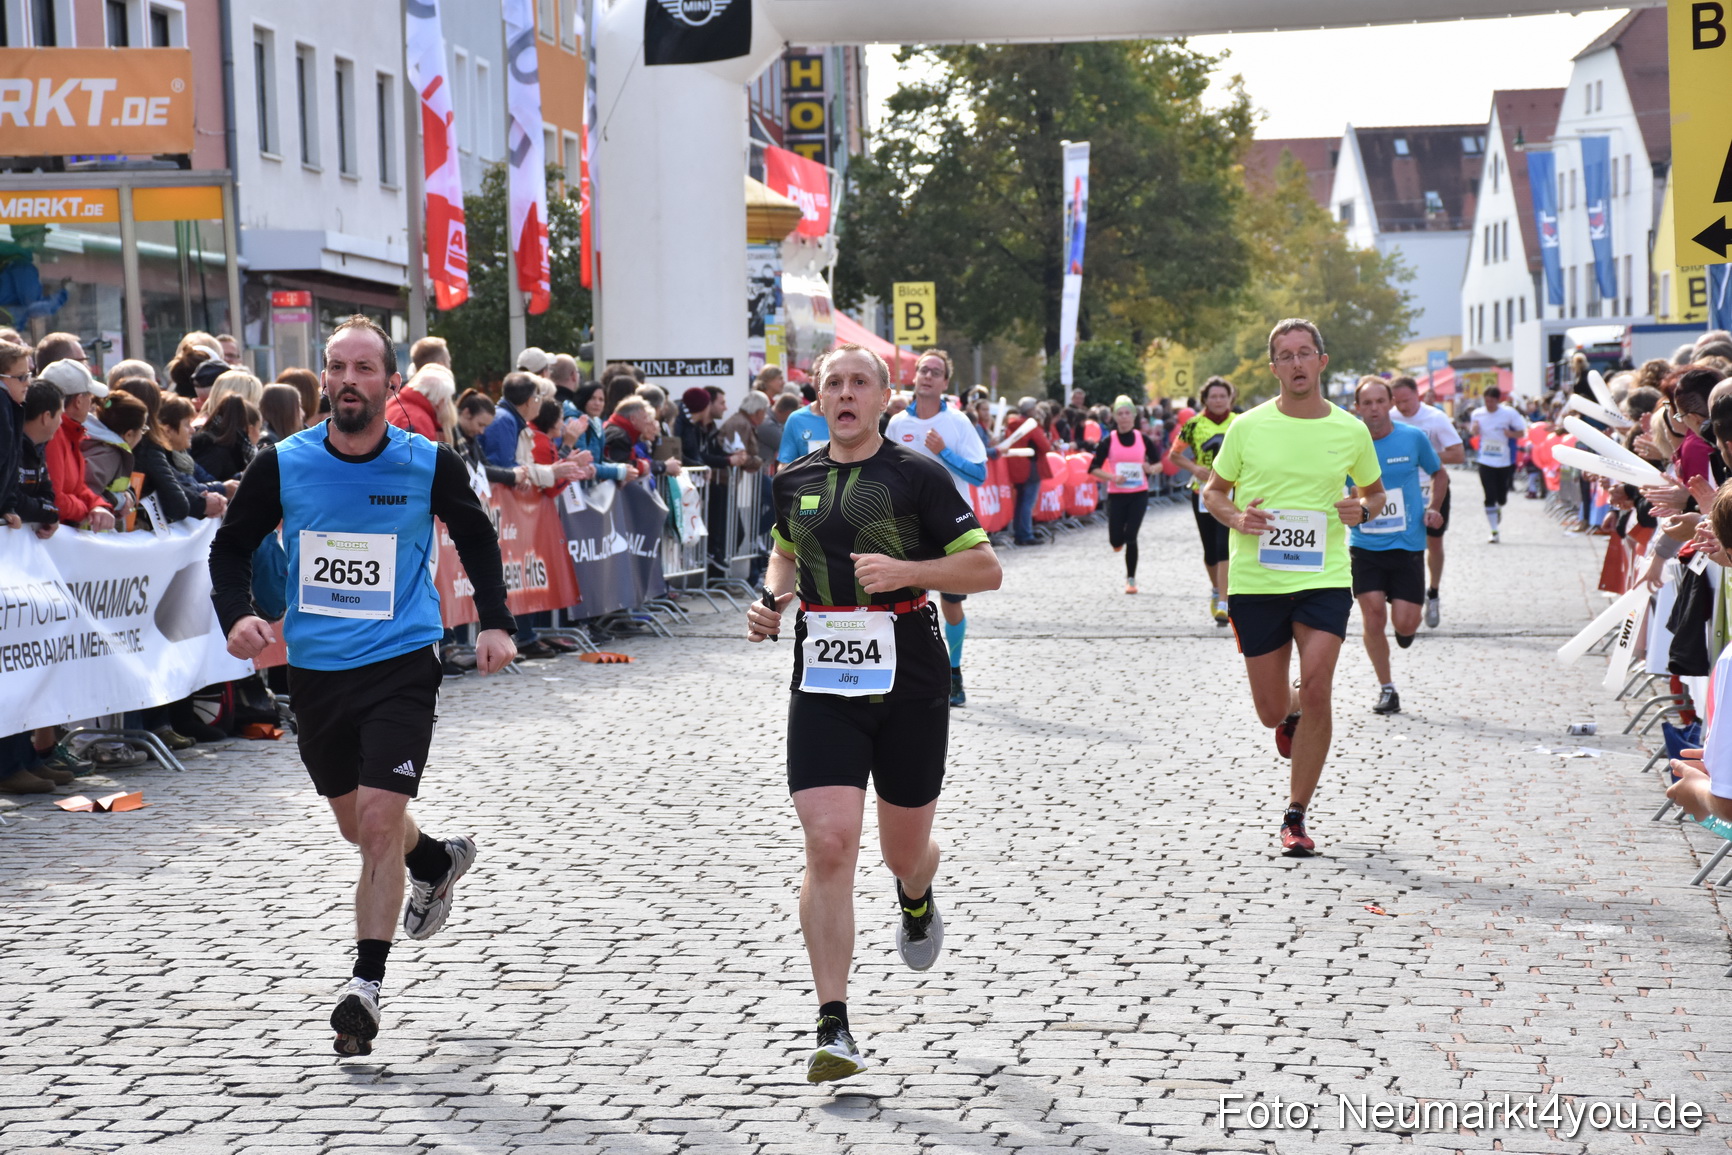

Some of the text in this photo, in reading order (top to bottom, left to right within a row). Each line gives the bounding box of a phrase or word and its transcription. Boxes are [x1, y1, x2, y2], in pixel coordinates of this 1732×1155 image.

[683, 1, 711, 12] MINI
[1692, 2, 1727, 50] B
[898, 285, 931, 298] Block
[905, 302, 926, 331] B
[1174, 369, 1188, 388] C
[368, 495, 408, 506] THULE
[1269, 528, 1316, 548] 2384
[335, 540, 369, 550] BOCK
[1283, 553, 1301, 561] Maik
[314, 556, 380, 586] 2653
[331, 592, 361, 604] Marco
[834, 620, 867, 629] BOCK
[1619, 618, 1635, 650] swn
[0, 633, 78, 673] ERBRAUCH.
[815, 639, 882, 665] 2254
[838, 673, 859, 685] Jörg
[392, 767, 417, 778] adidas
